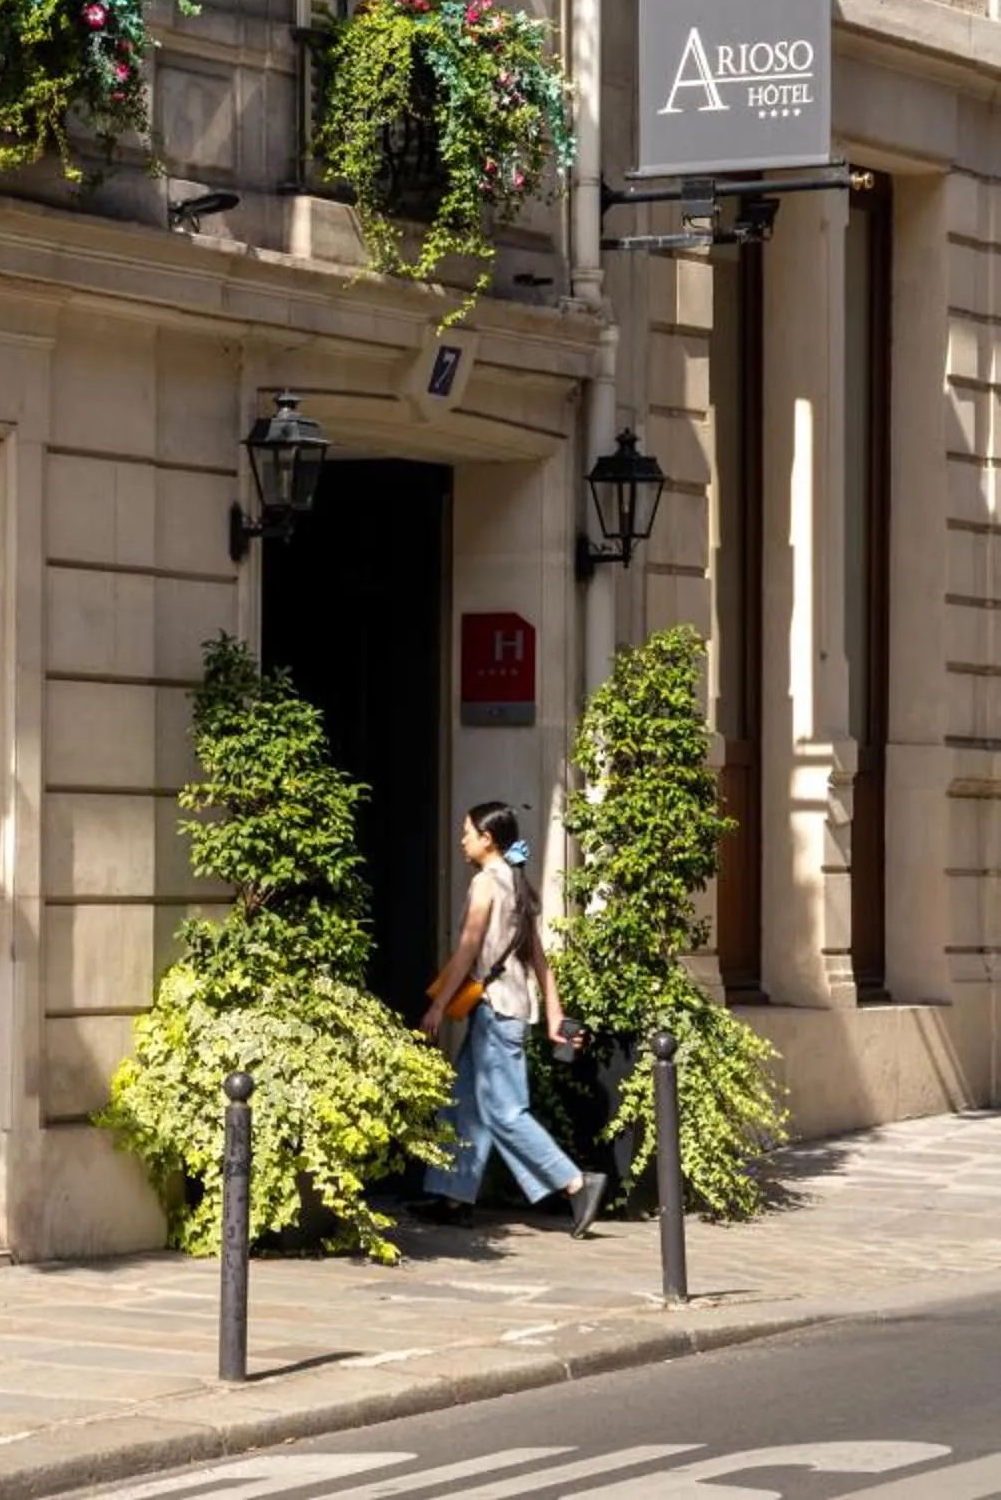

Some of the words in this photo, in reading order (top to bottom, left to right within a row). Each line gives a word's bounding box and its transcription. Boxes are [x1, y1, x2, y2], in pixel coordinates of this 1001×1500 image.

[658, 27, 814, 114] ARIOSO
[748, 83, 813, 107] HÔTEL
[434, 351, 456, 388] 7
[494, 629, 524, 661] H
